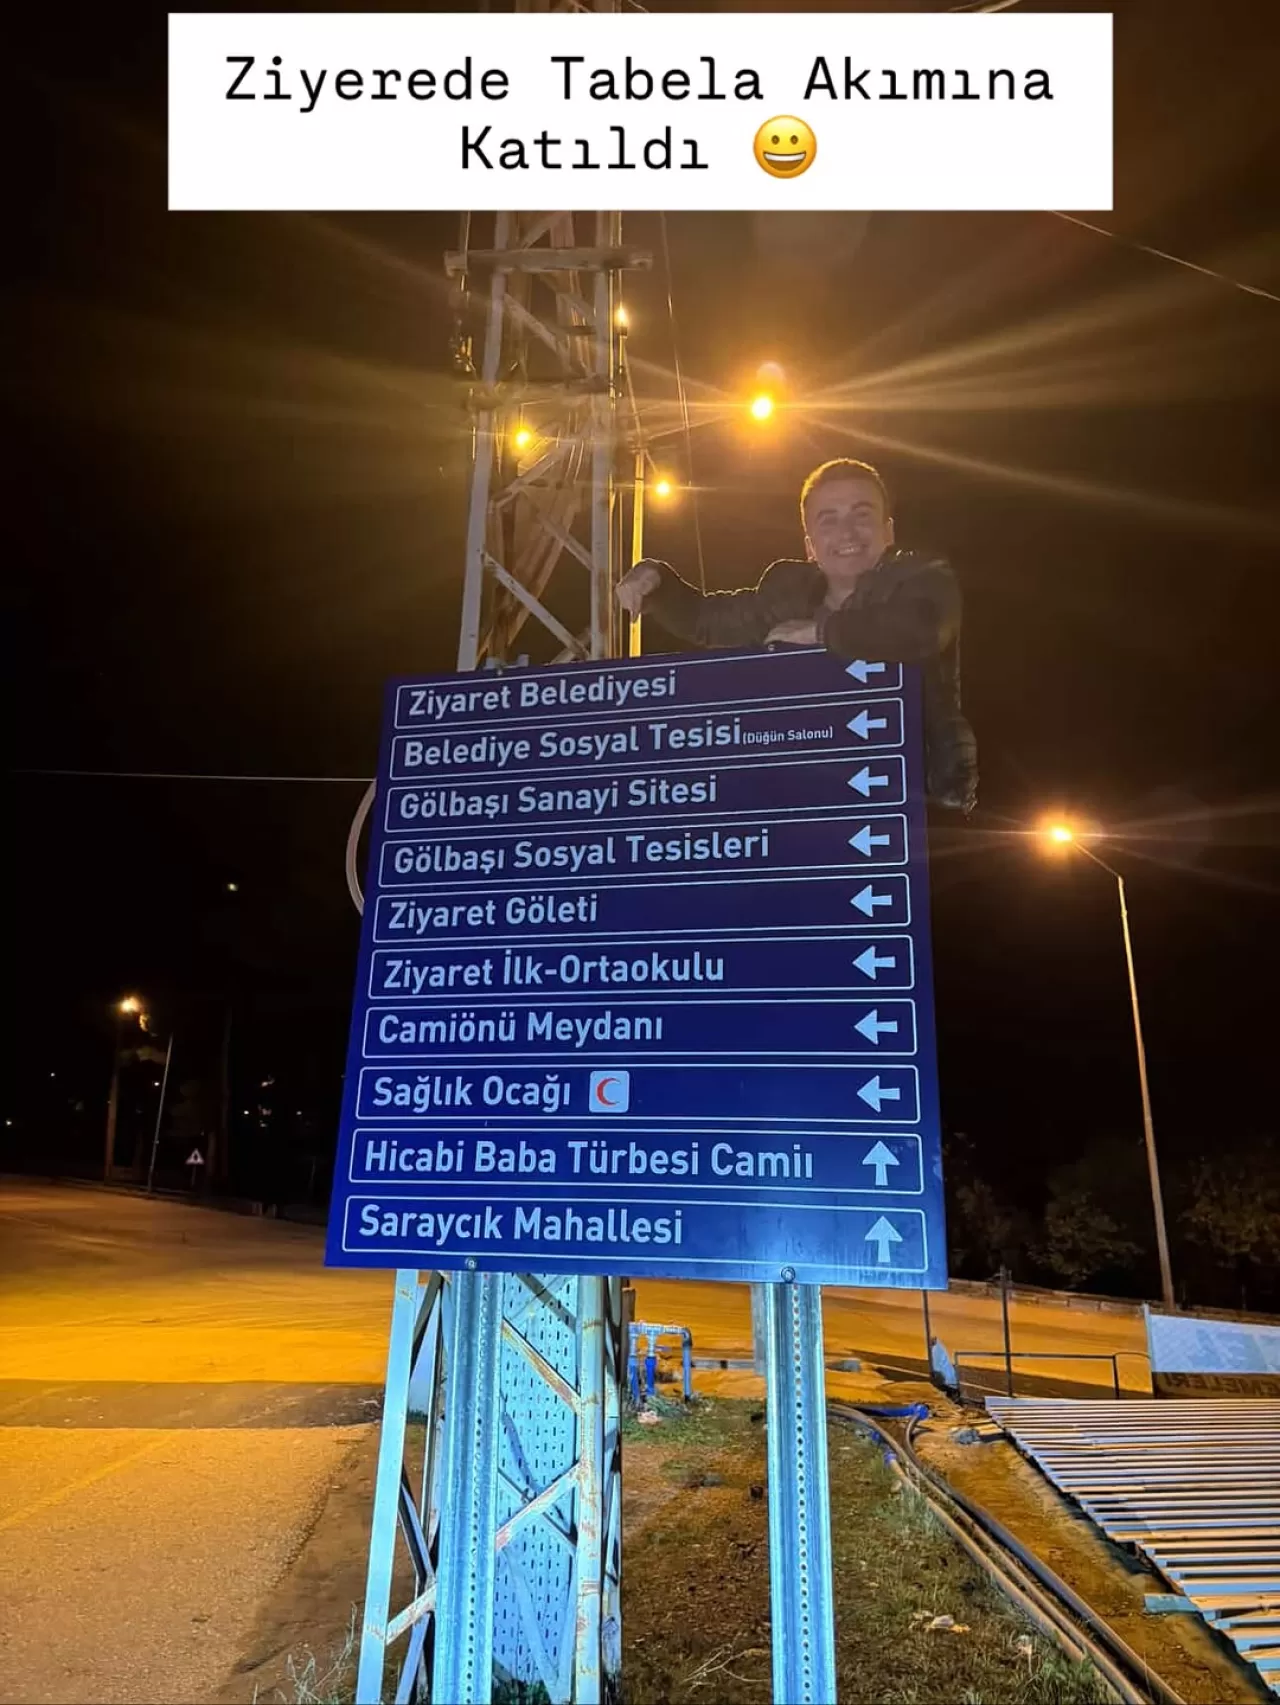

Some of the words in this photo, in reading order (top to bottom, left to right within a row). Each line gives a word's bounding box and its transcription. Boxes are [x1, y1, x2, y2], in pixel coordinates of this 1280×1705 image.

[408, 685, 512, 720] Ziyaret
[520, 669, 677, 708] Belediyesi
[404, 735, 531, 768] Belediye
[539, 725, 640, 761] Sosyal
[648, 717, 741, 750] Tesisi
[787, 725, 833, 742] Salonu)
[400, 790, 509, 820] Gölbaşı
[517, 780, 619, 815] Sanayi
[627, 774, 717, 806] Sitesi
[394, 845, 505, 875] Gölbaşı
[513, 836, 616, 873] Sosyal
[625, 828, 769, 863] Tesisleri
[388, 899, 496, 935] Ziyaret
[505, 892, 598, 925] Göleti
[383, 958, 494, 995] Ziyaret
[503, 948, 724, 985] İlk-Ortaokulu
[378, 1011, 516, 1044] Camiönü
[527, 1010, 663, 1048] Meydanı
[372, 1075, 473, 1114] Sağlık
[482, 1074, 571, 1113] Ocağı
[364, 1140, 465, 1172] Hicabi
[474, 1140, 557, 1174] Baba
[567, 1140, 699, 1175] Türbesi
[358, 1203, 503, 1246] Saraycık
[513, 1206, 682, 1244] Mahallesi
